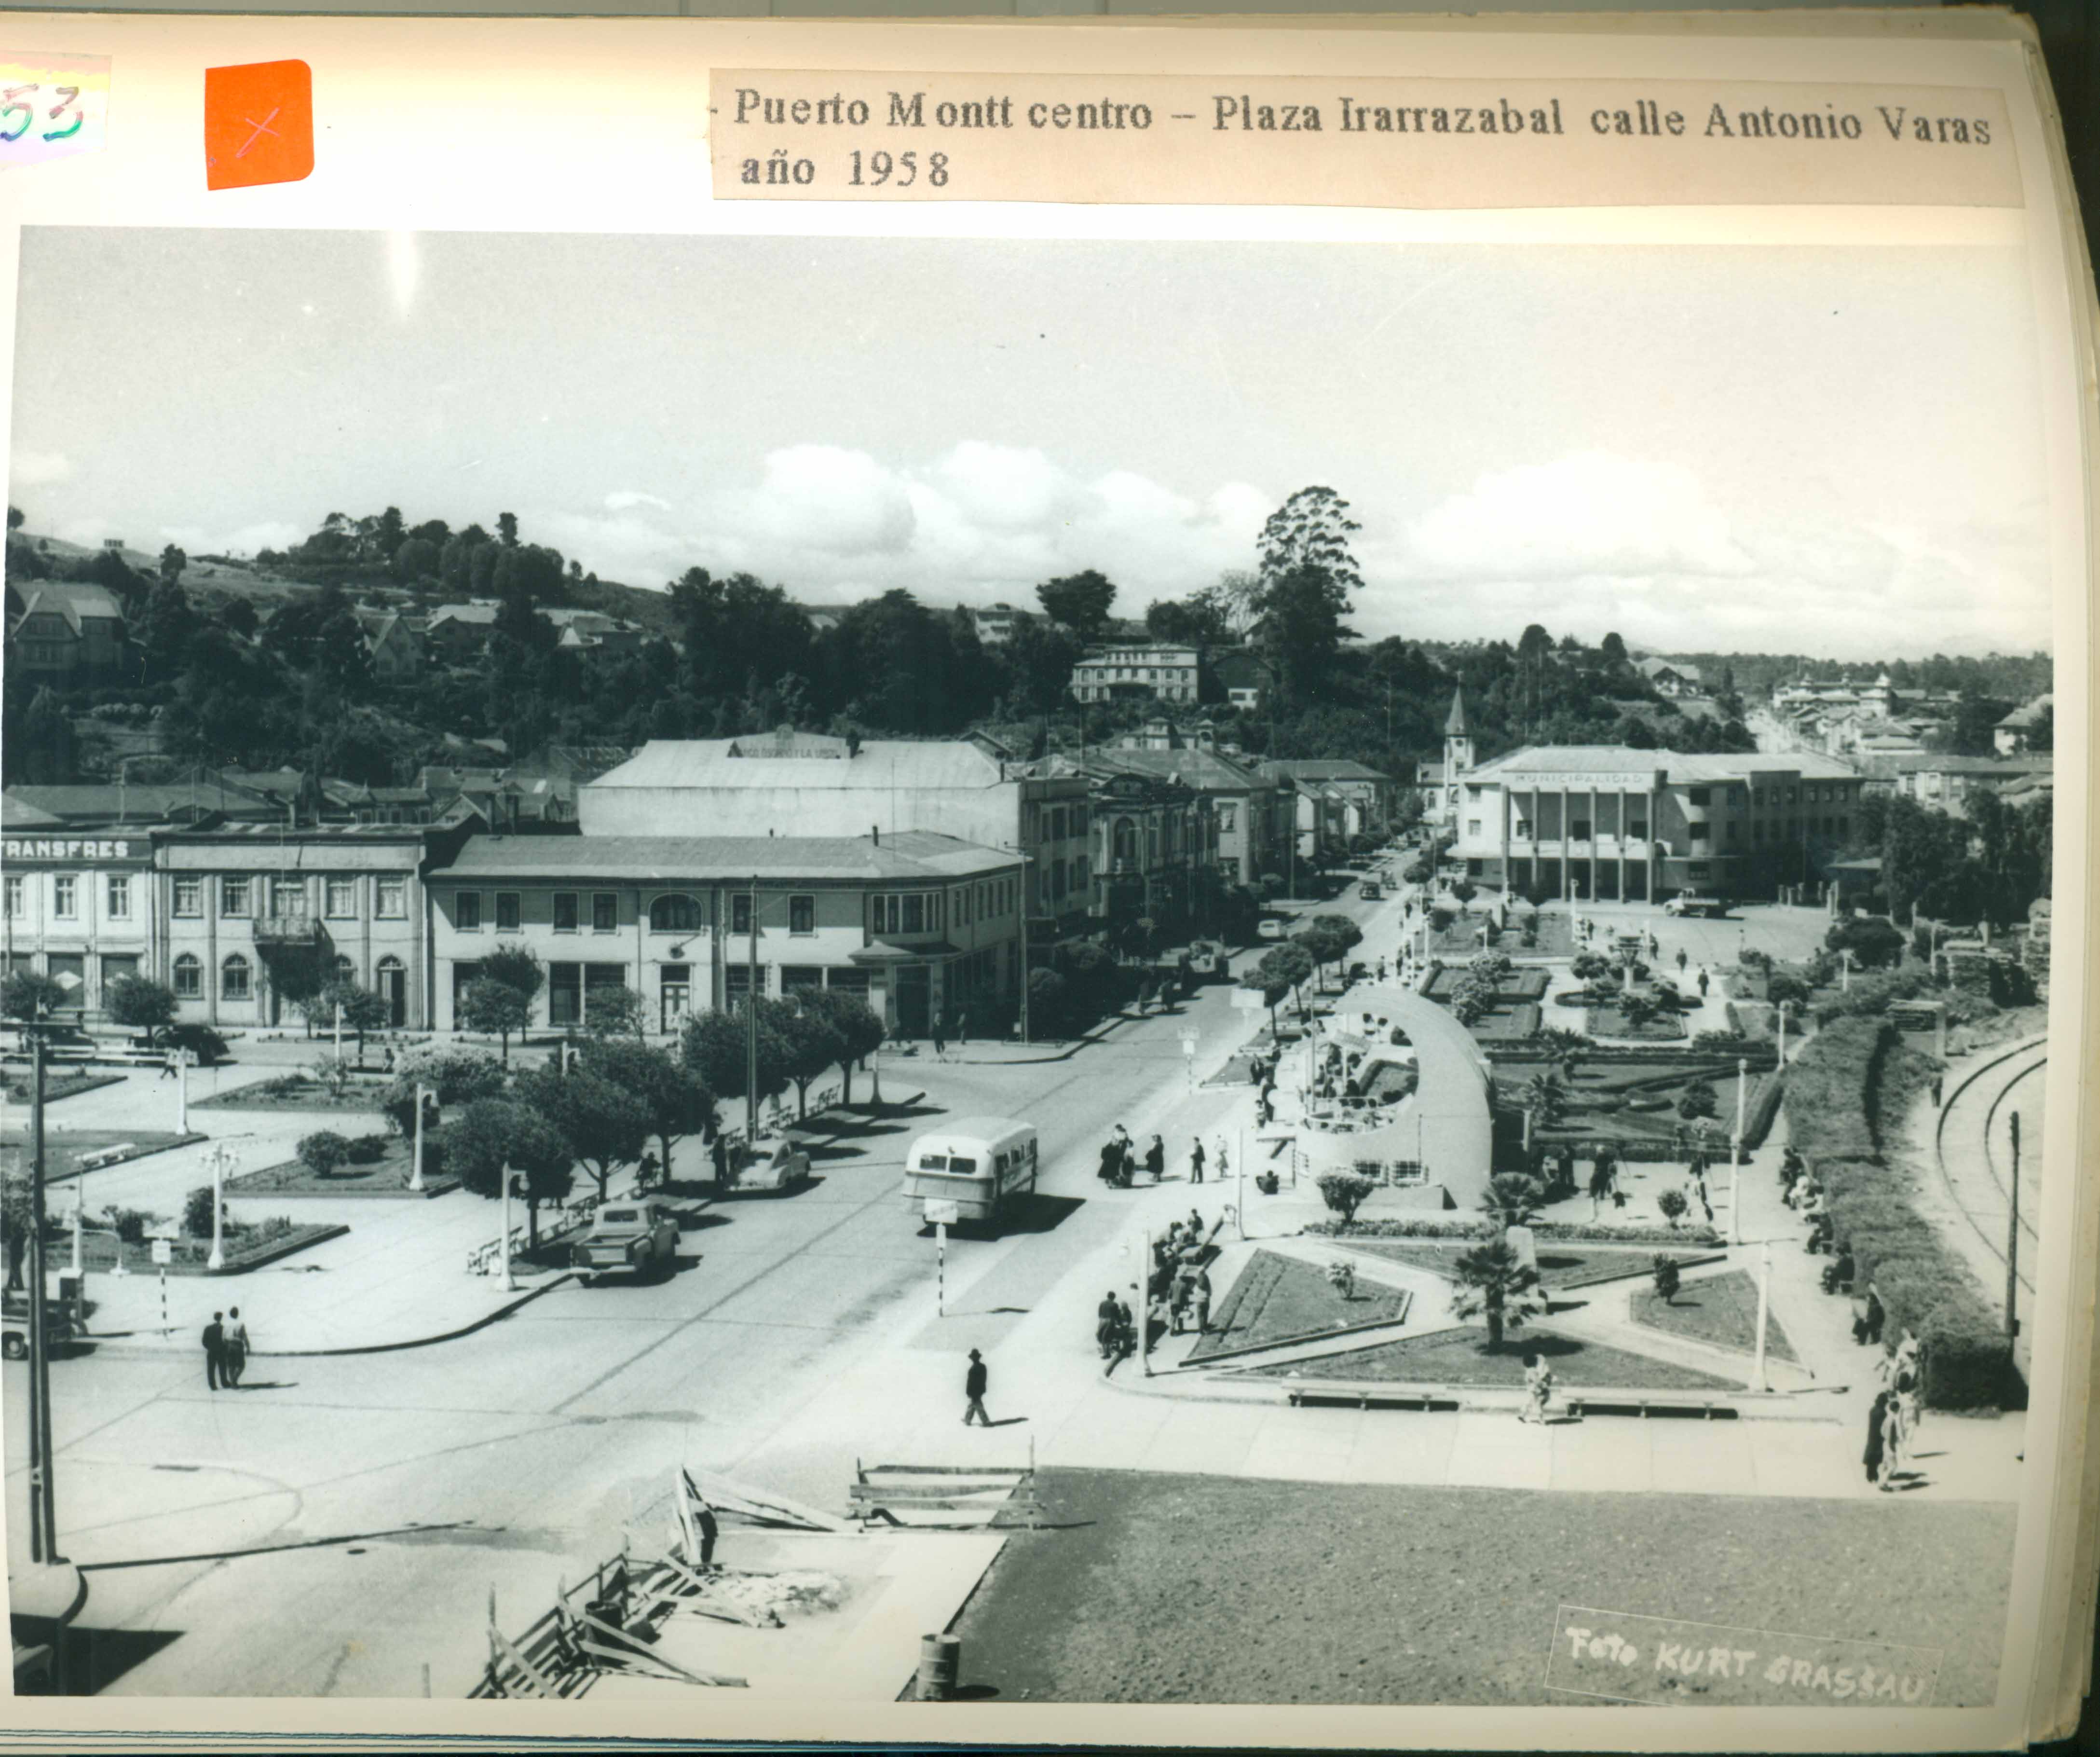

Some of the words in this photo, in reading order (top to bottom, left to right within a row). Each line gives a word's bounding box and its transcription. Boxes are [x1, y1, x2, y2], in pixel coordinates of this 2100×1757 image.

[734, 89, 870, 127] Puerto
[887, 92, 1013, 128] Montt
[1028, 98, 1152, 129] centro
[1213, 96, 1323, 131] Plaza
[1340, 98, 1563, 135] Irarrazabal
[1590, 99, 1685, 136] calle
[1704, 103, 1862, 139] Antonio
[1877, 106, 1991, 144] Varas
[741, 149, 816, 185] año
[848, 150, 950, 187] 1958
[1515, 774, 1643, 783] MUNICIPALIDAD
